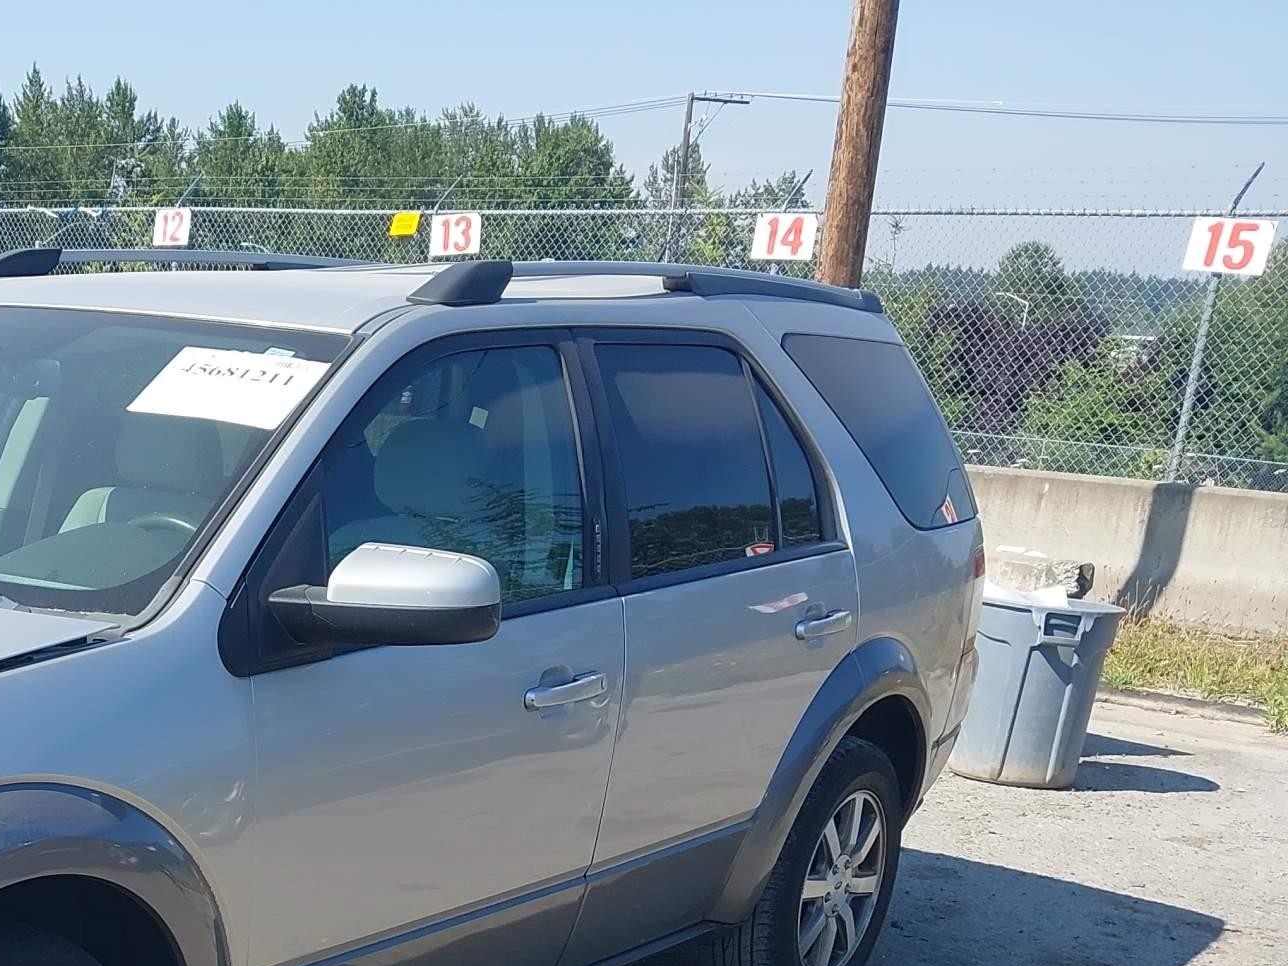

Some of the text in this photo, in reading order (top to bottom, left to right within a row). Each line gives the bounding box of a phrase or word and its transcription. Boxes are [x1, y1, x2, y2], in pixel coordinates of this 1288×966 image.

[161, 212, 184, 243] 12
[440, 215, 473, 252] 13
[765, 216, 804, 256] 14
[1203, 221, 1261, 271] 15
